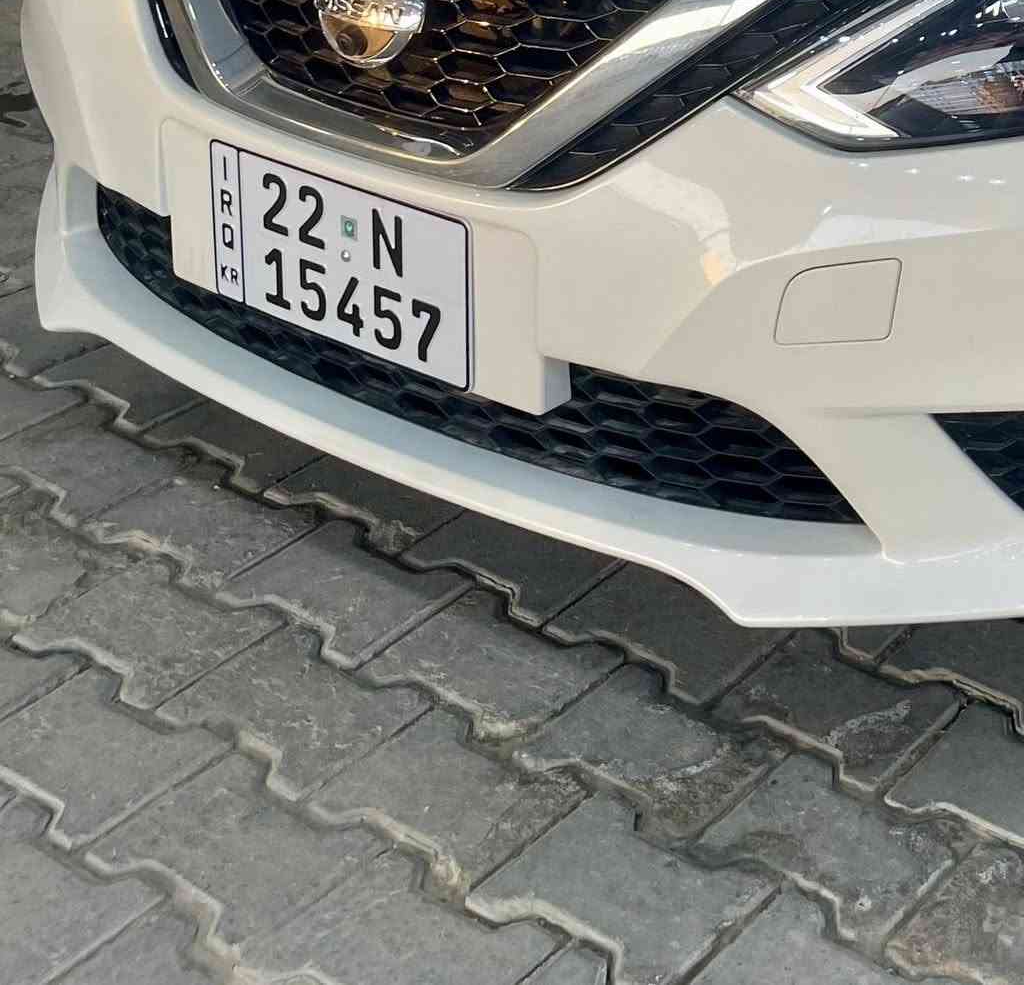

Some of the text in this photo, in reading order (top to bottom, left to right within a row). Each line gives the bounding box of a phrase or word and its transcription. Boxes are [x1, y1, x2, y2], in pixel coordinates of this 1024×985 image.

[220, 264, 240, 287] KR
[262, 172, 404, 278] 22 N
[264, 247, 441, 362] 15457
